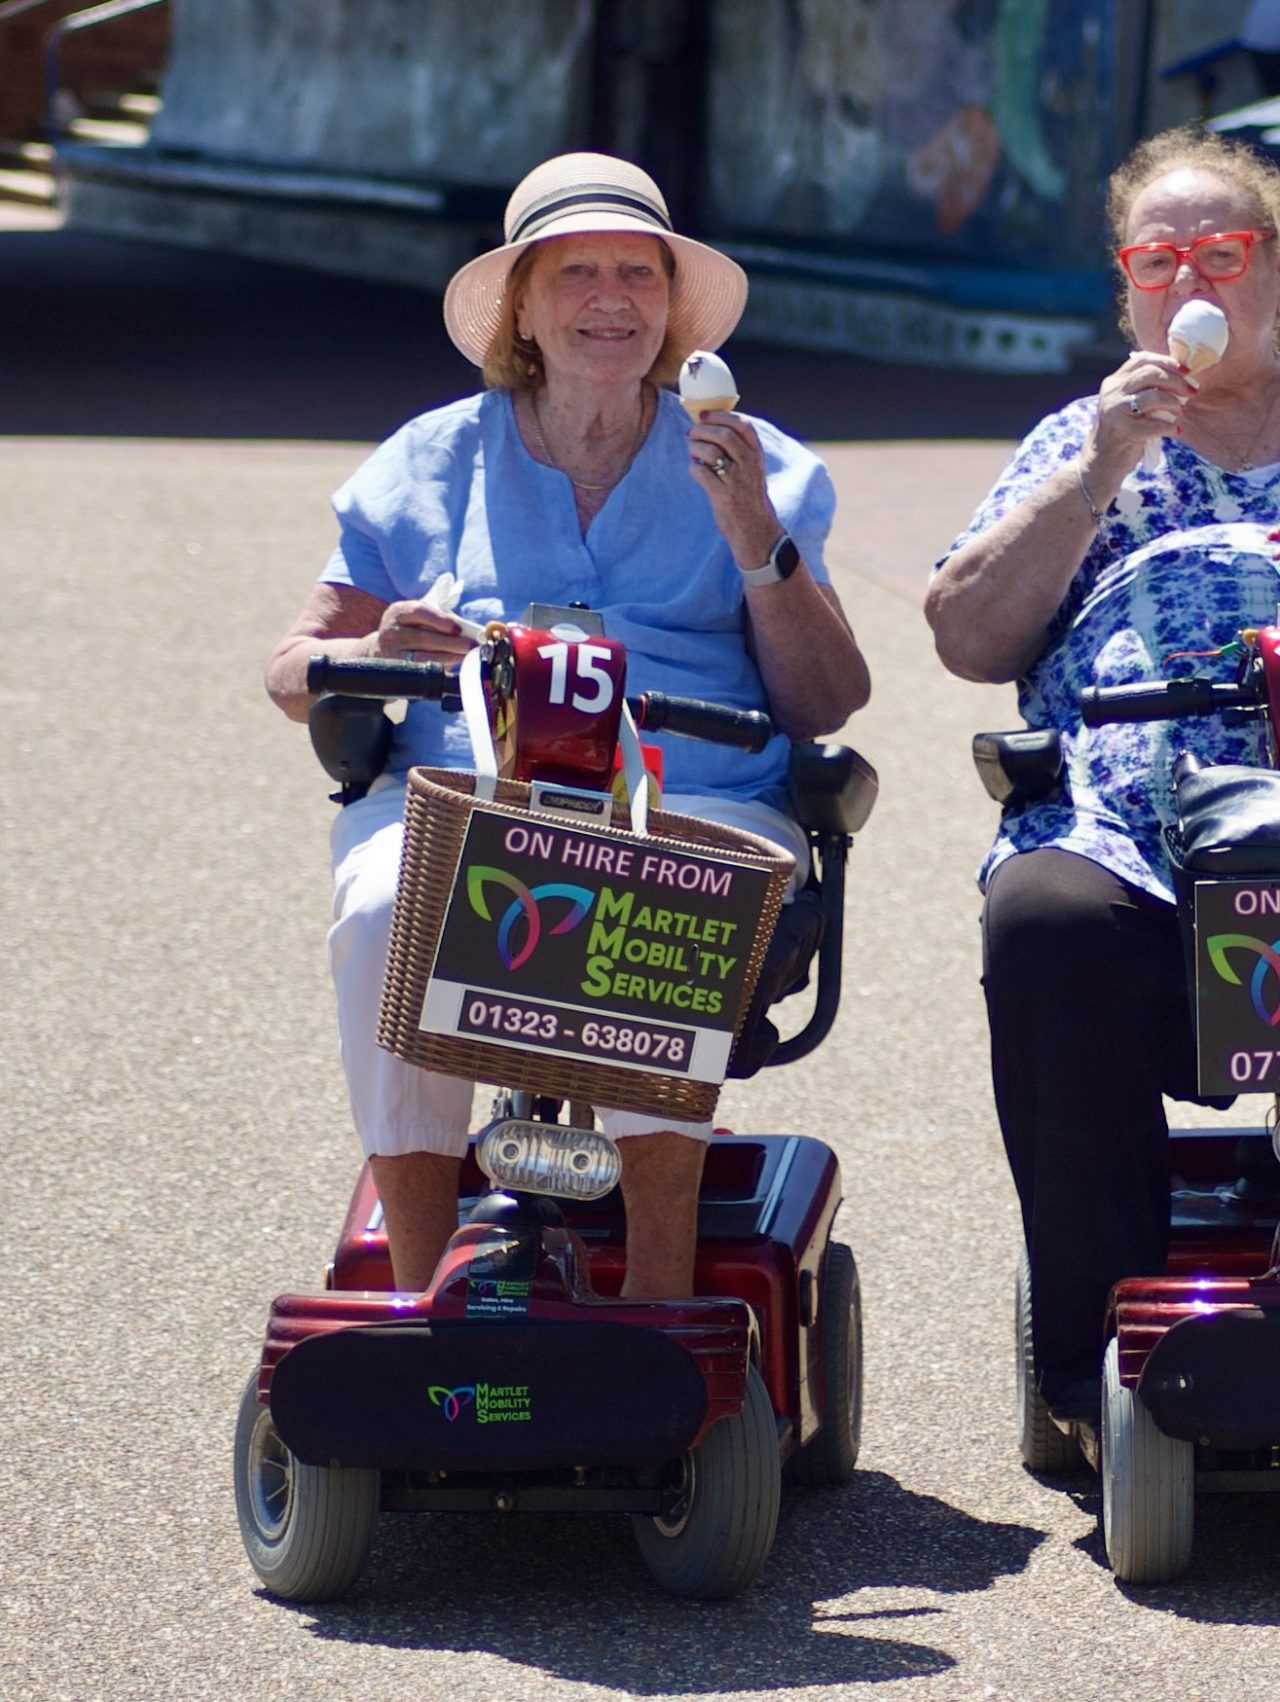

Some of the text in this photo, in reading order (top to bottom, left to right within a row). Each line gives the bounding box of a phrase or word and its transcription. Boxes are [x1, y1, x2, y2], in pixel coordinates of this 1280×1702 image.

[537, 642, 614, 713] 15
[504, 826, 733, 897] ON HIRE FROM
[594, 886, 738, 946] MARTLET
[585, 920, 738, 981] MOBILTY
[580, 956, 723, 1015] SERVICES
[468, 1000, 558, 1039] 01323
[581, 1022, 686, 1063] 638078
[476, 1383, 529, 1397] MARTLET
[476, 1397, 531, 1409] MOBILITY
[477, 1410, 531, 1423] SERVICES
